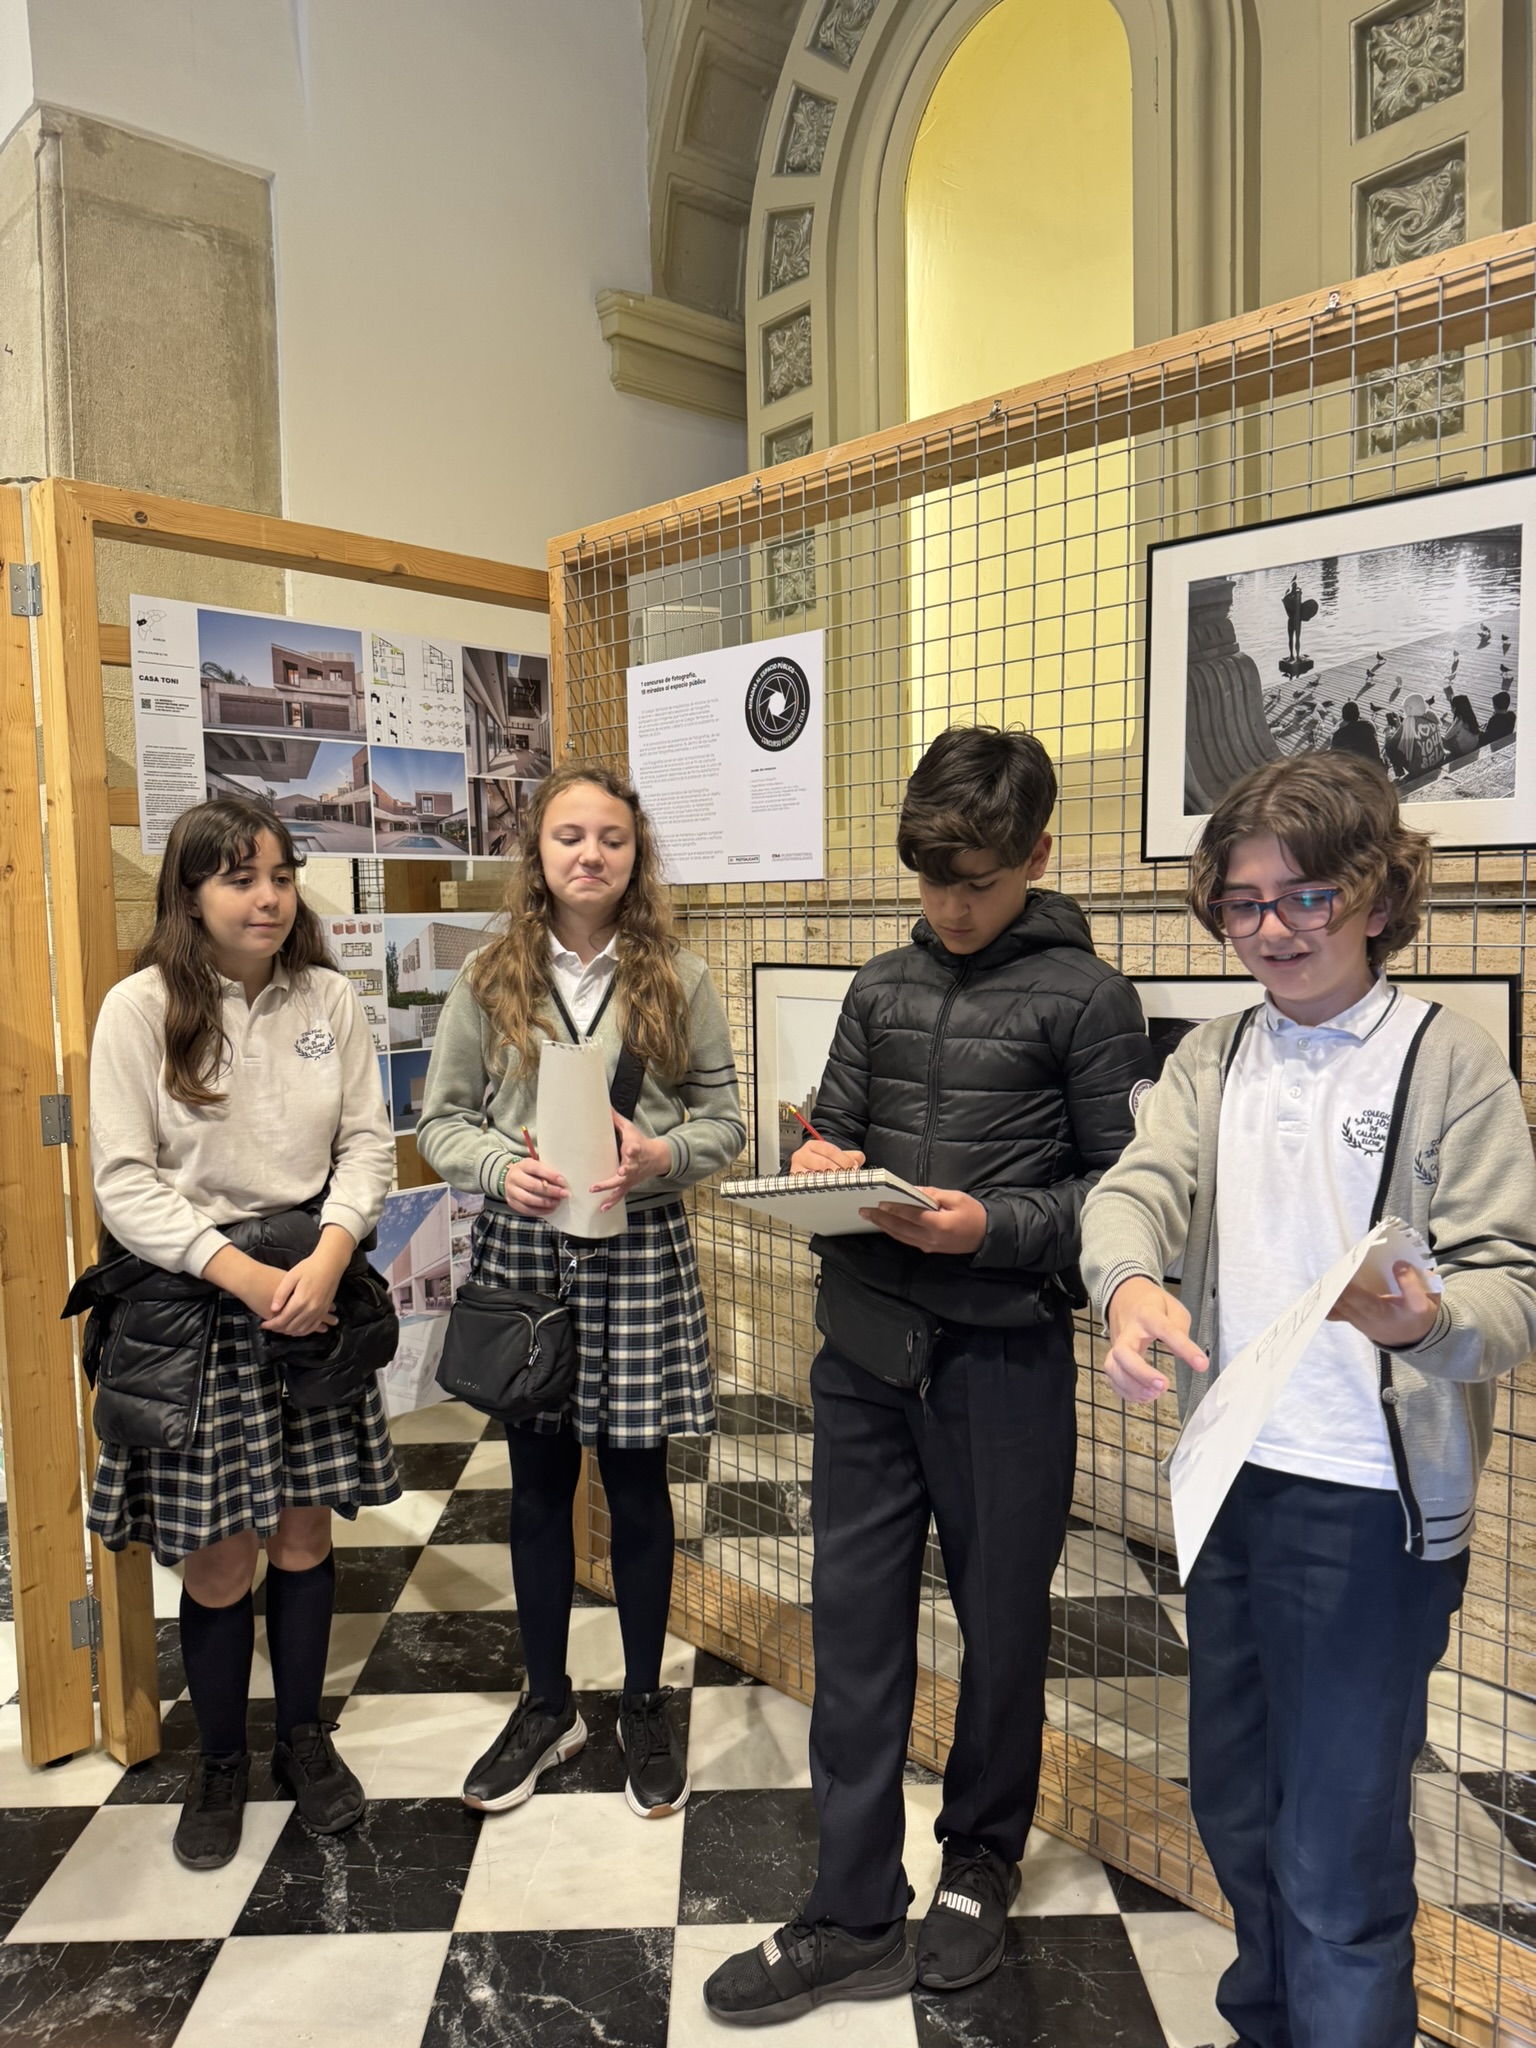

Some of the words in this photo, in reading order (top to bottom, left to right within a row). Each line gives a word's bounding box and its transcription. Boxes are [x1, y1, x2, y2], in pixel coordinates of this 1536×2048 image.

[138, 674, 160, 683] CASA
[160, 676, 179, 685] TONI
[643, 679, 664, 688] concurso
[646, 685, 665, 694] miradas
[670, 680, 689, 691] espacio
[1354, 1117, 1373, 1126] SAN
[1369, 1125, 1378, 1133] DE
[1356, 1130, 1386, 1141] CALASAN
[1361, 1138, 1381, 1147] ELCHE
[937, 1890, 982, 1919] PUMA
